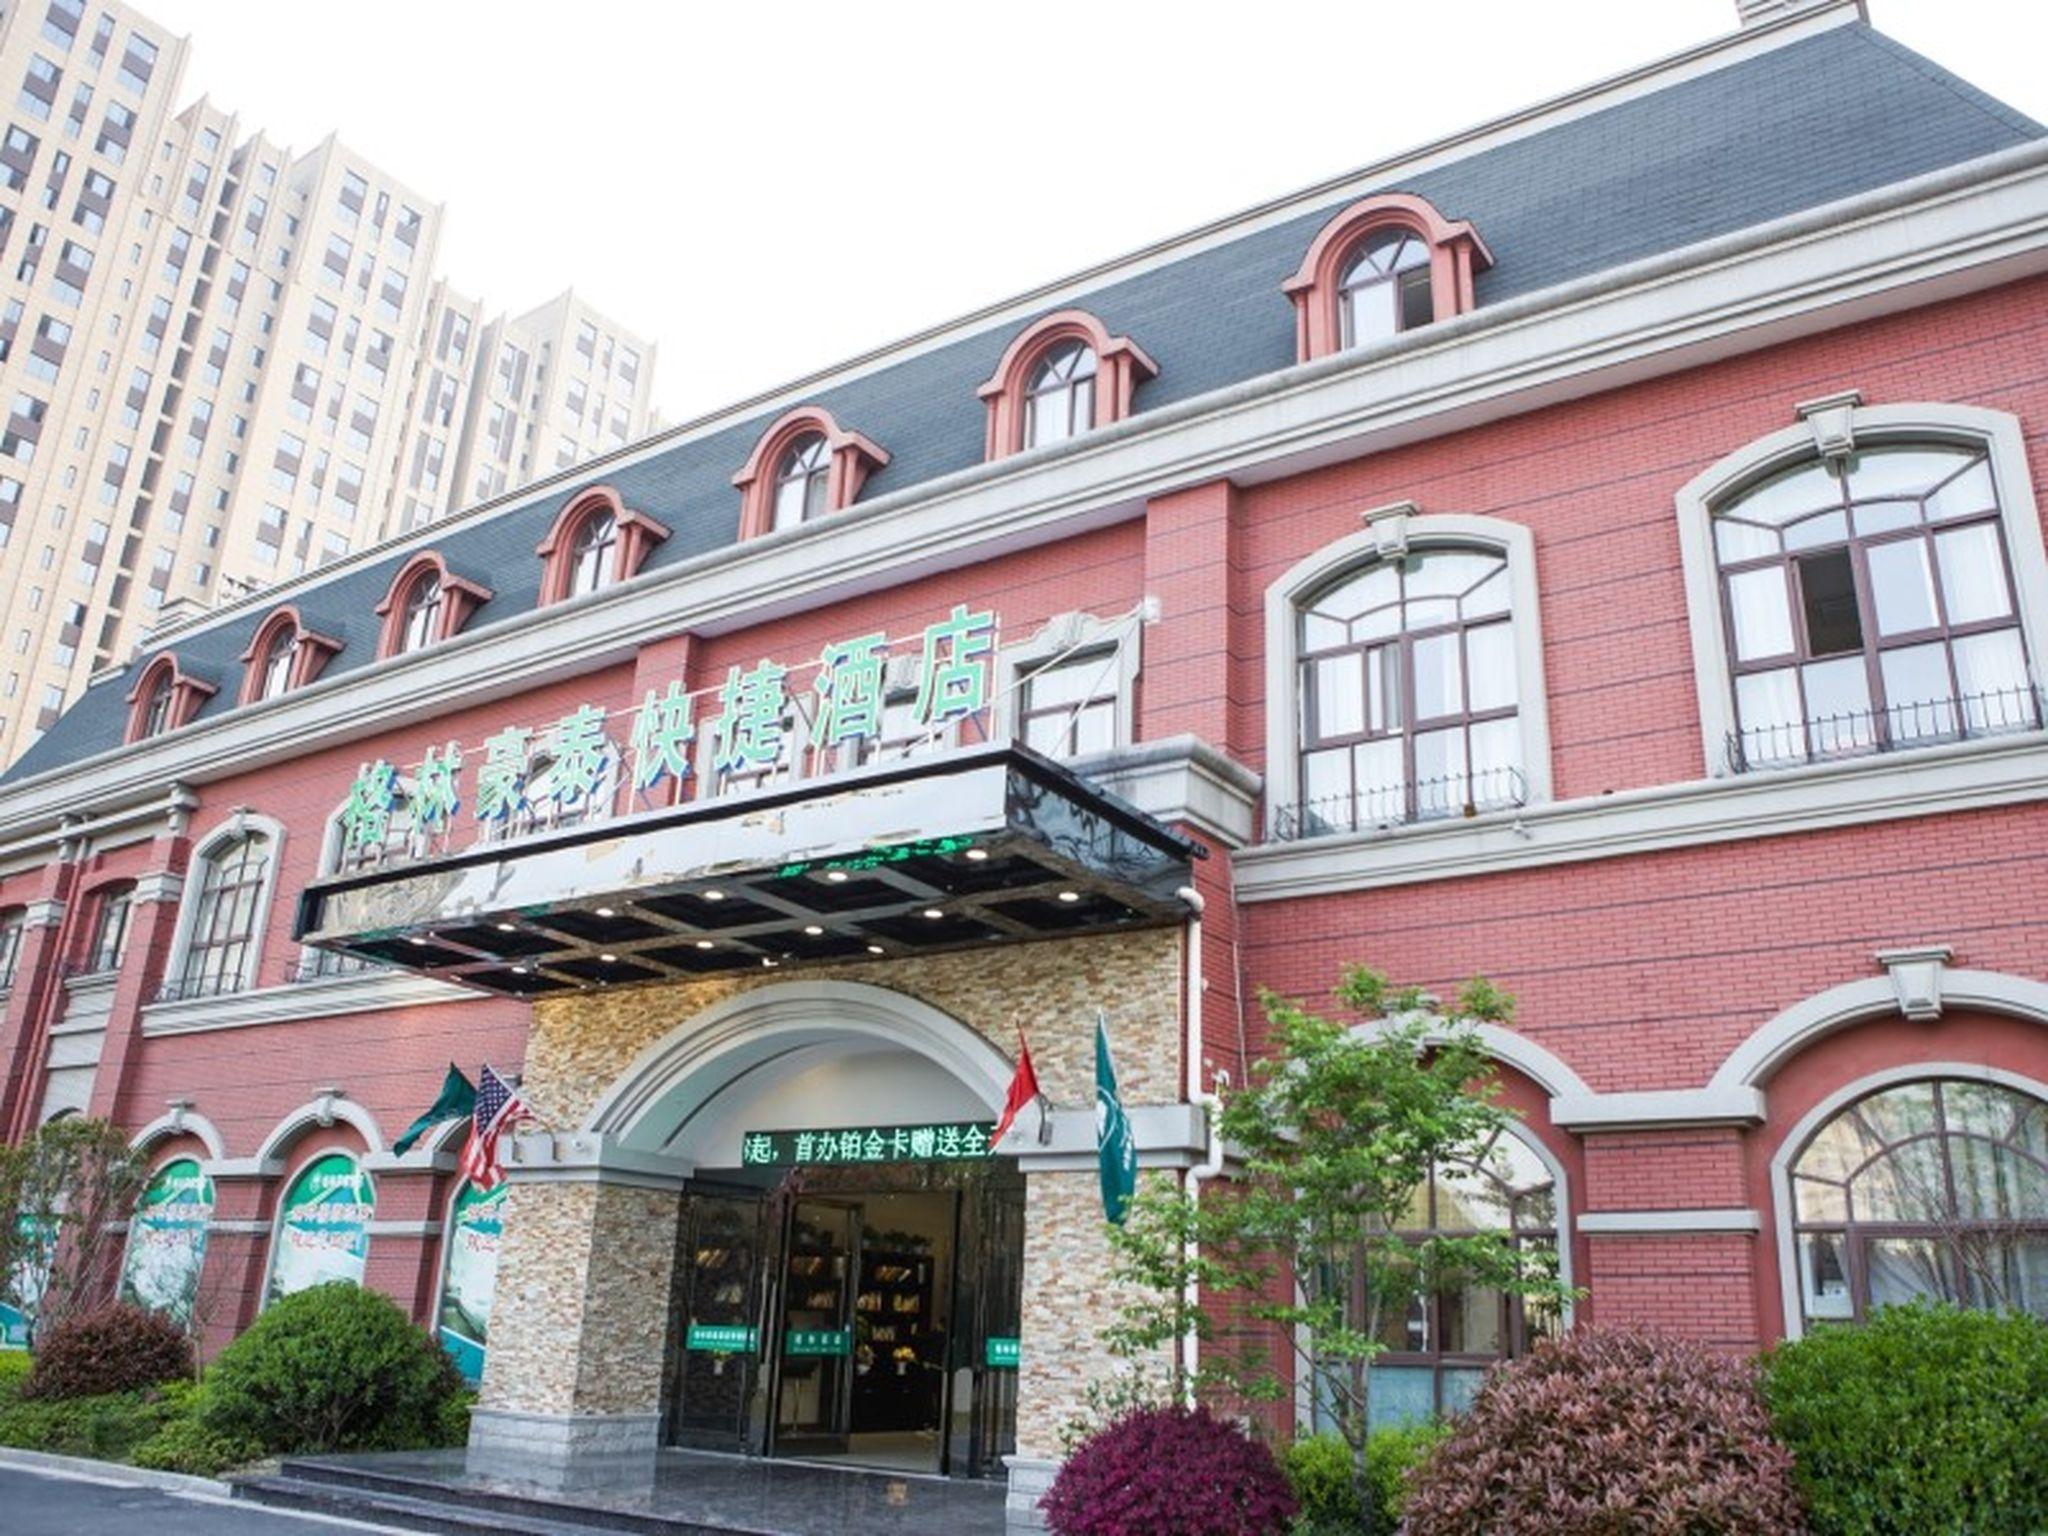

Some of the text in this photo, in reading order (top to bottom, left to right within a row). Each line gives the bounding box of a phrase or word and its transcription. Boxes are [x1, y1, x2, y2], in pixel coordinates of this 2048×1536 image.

[344, 604, 995, 848] 格林豪泰快捷酒店
[744, 1123, 998, 1163] 起，首办铂金卡赠送全
